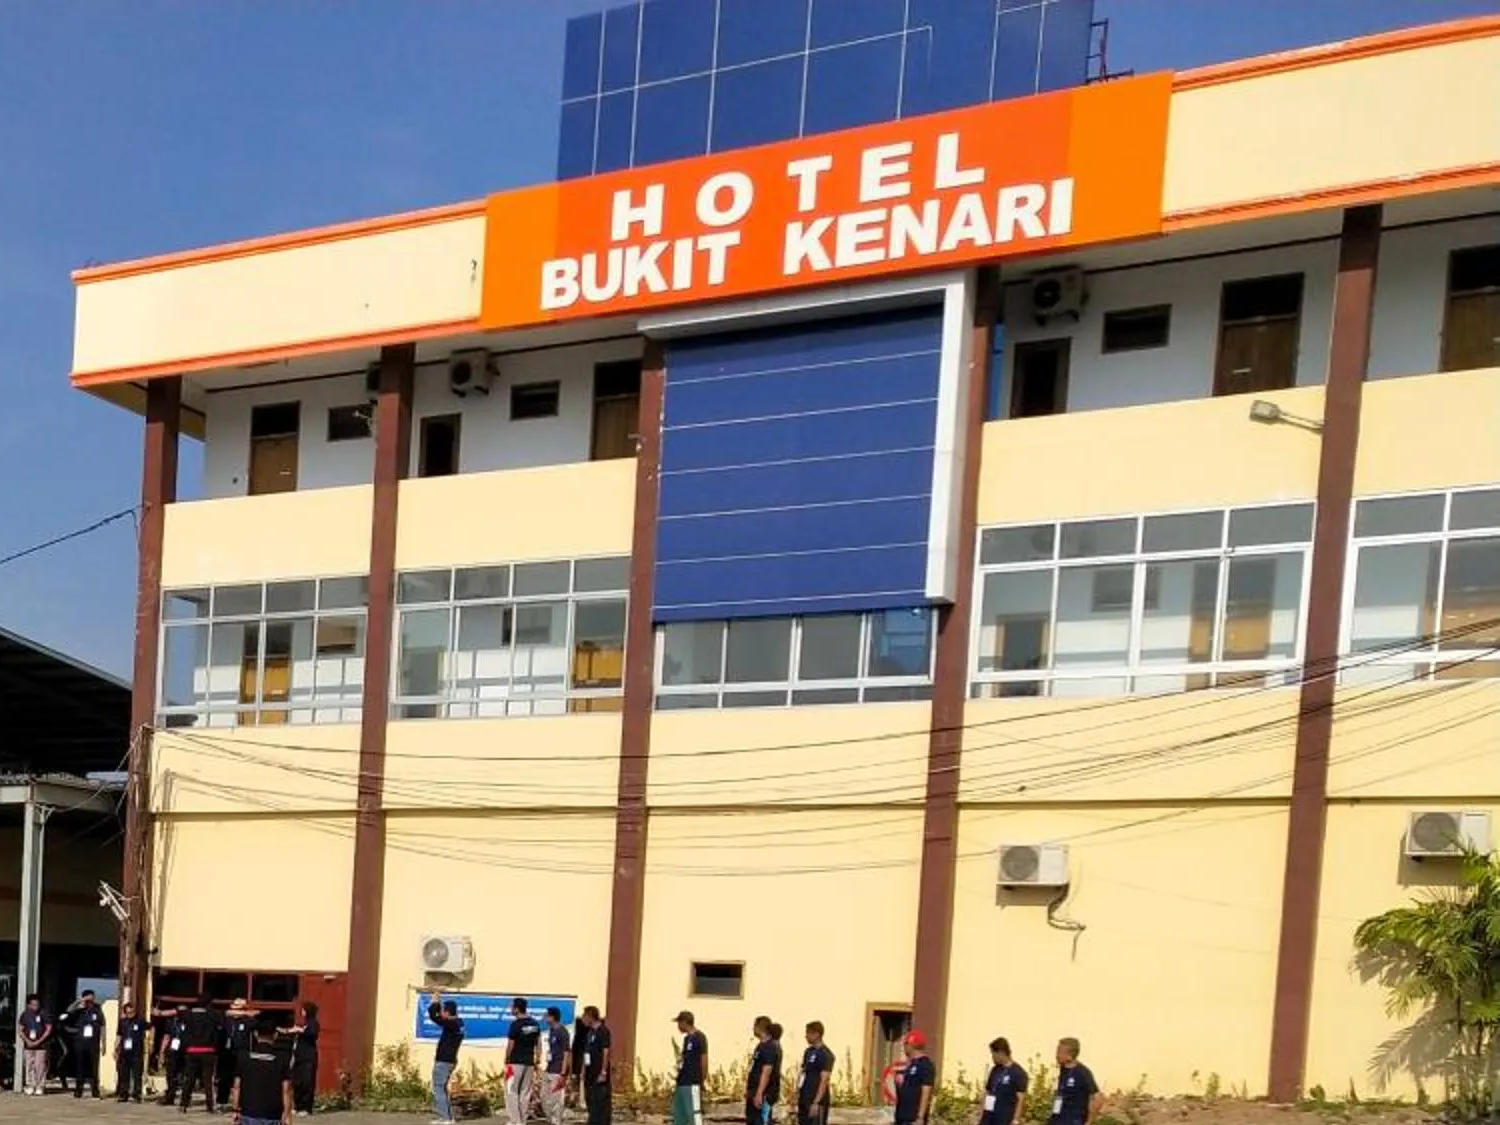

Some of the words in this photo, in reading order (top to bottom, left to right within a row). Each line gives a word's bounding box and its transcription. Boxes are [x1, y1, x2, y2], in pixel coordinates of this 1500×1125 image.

[540, 231, 740, 310] BUKIT
[783, 178, 1074, 275] KENARI
[610, 132, 985, 241] HOTEL
